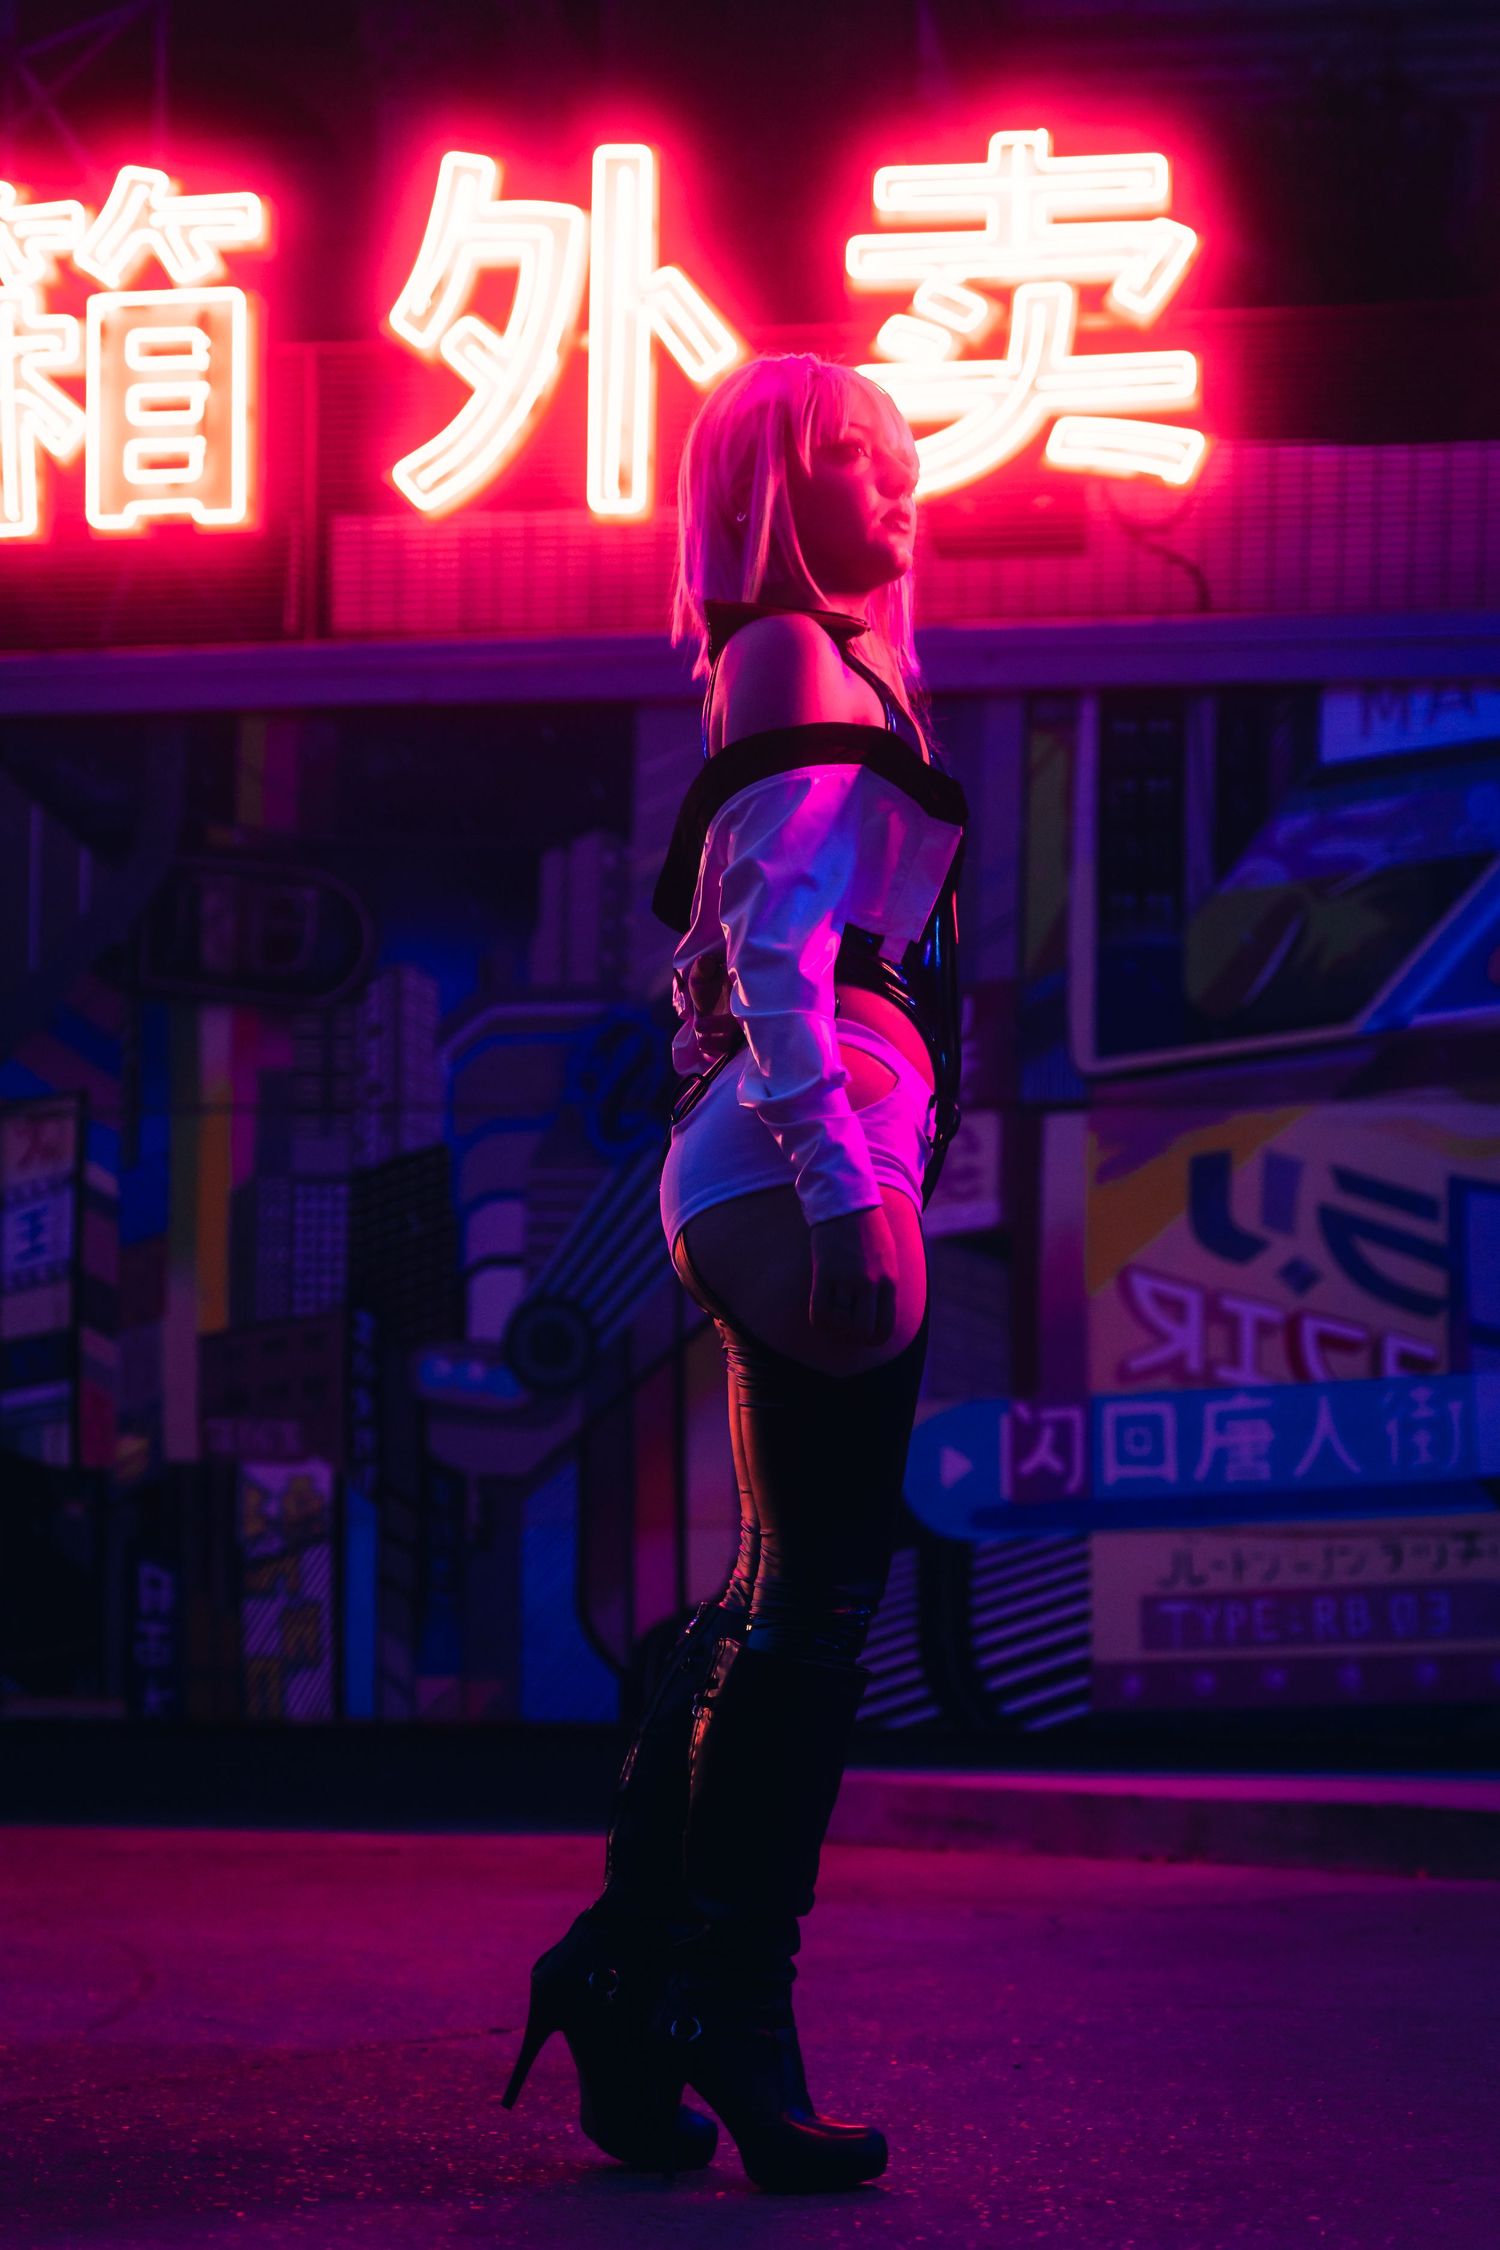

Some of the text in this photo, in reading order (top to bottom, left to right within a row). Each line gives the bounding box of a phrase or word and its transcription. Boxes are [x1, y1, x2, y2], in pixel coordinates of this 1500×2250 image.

[1000, 1386, 1464, 1501] 闪回唐人街
